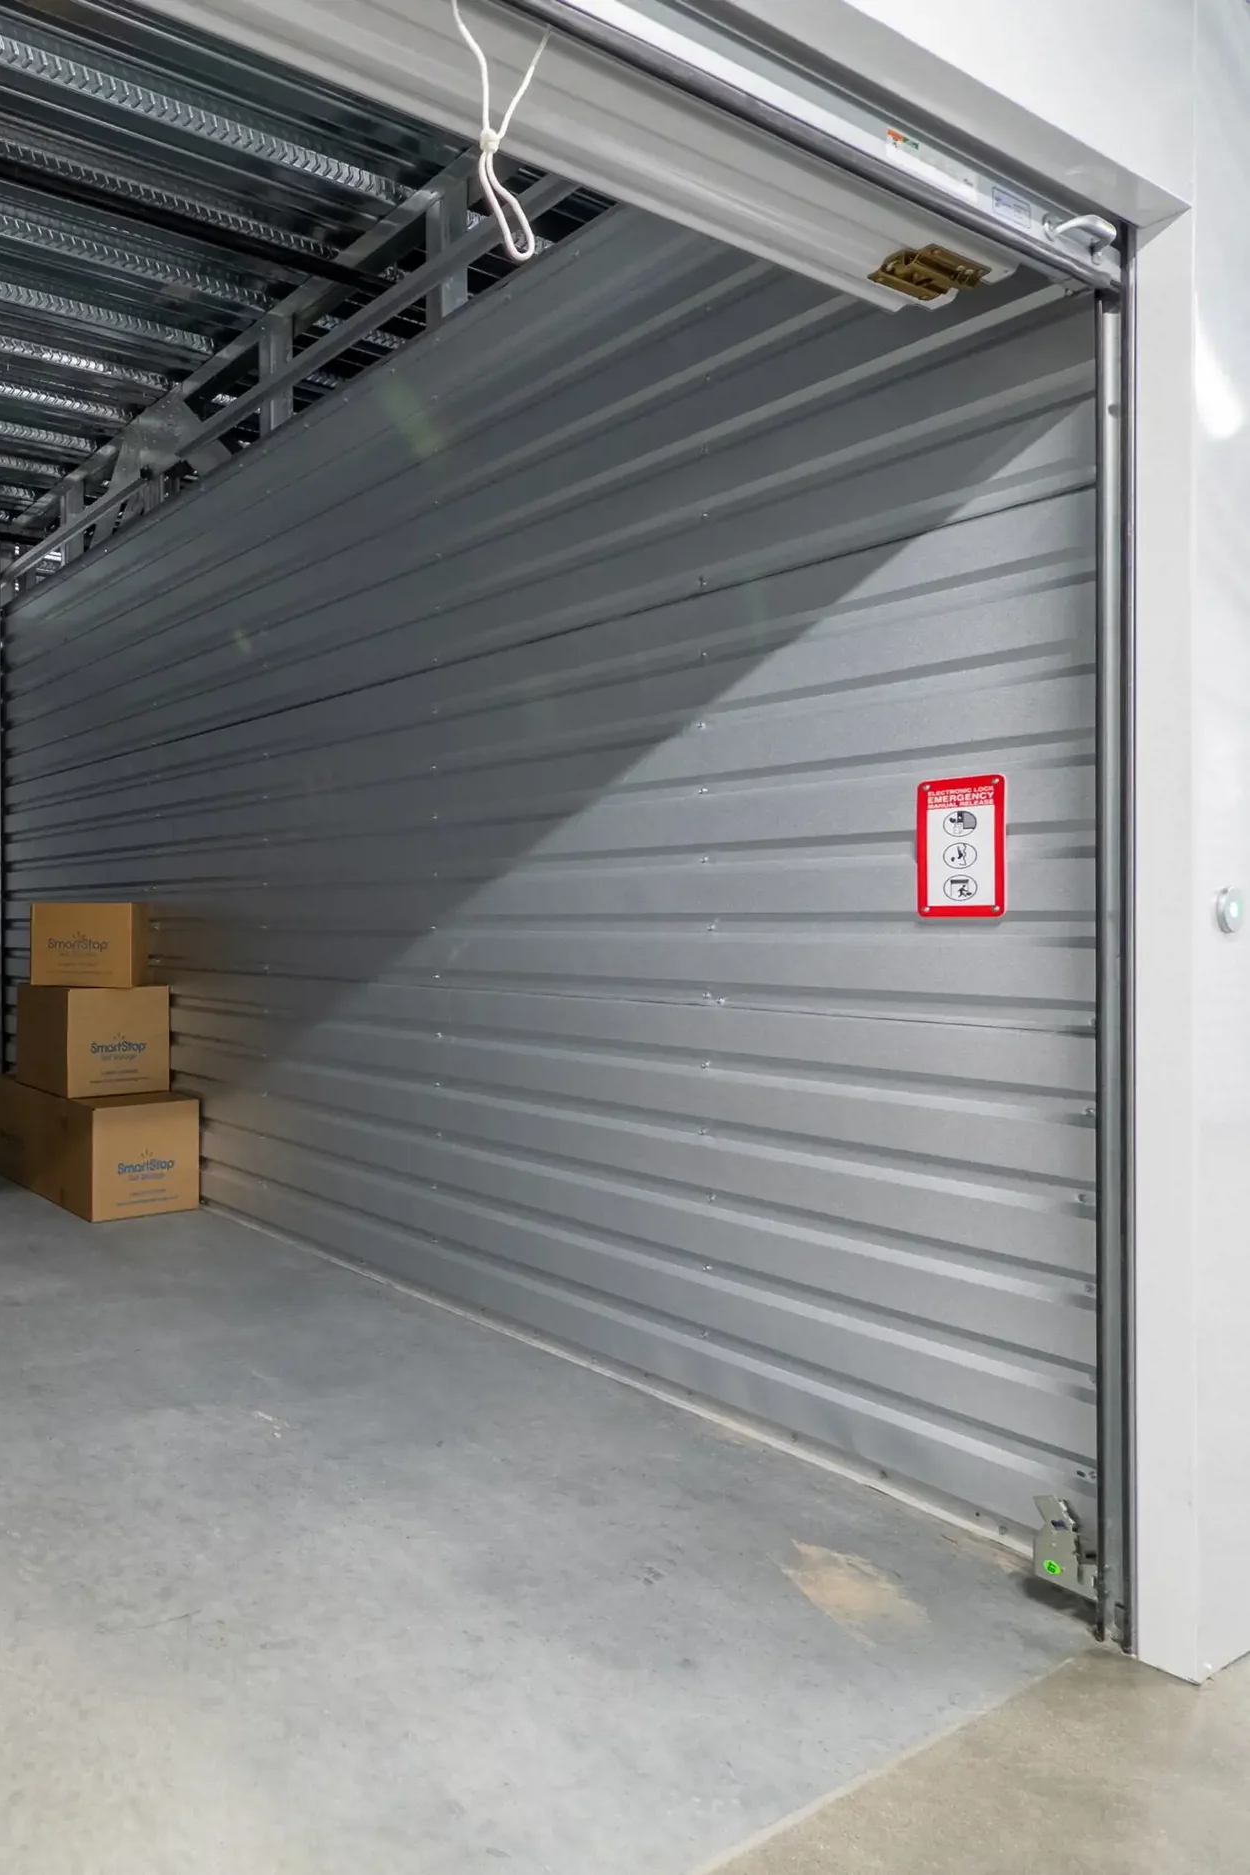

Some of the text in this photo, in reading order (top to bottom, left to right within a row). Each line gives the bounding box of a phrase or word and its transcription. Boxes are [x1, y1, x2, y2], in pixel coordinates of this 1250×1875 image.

[928, 788, 972, 796] ELECTRONIC
[928, 792, 994, 802] EMERGENCY
[48, 938, 109, 953] SmartStop
[90, 1040, 146, 1054] SmartStop
[117, 1158, 175, 1175] SmartStop
